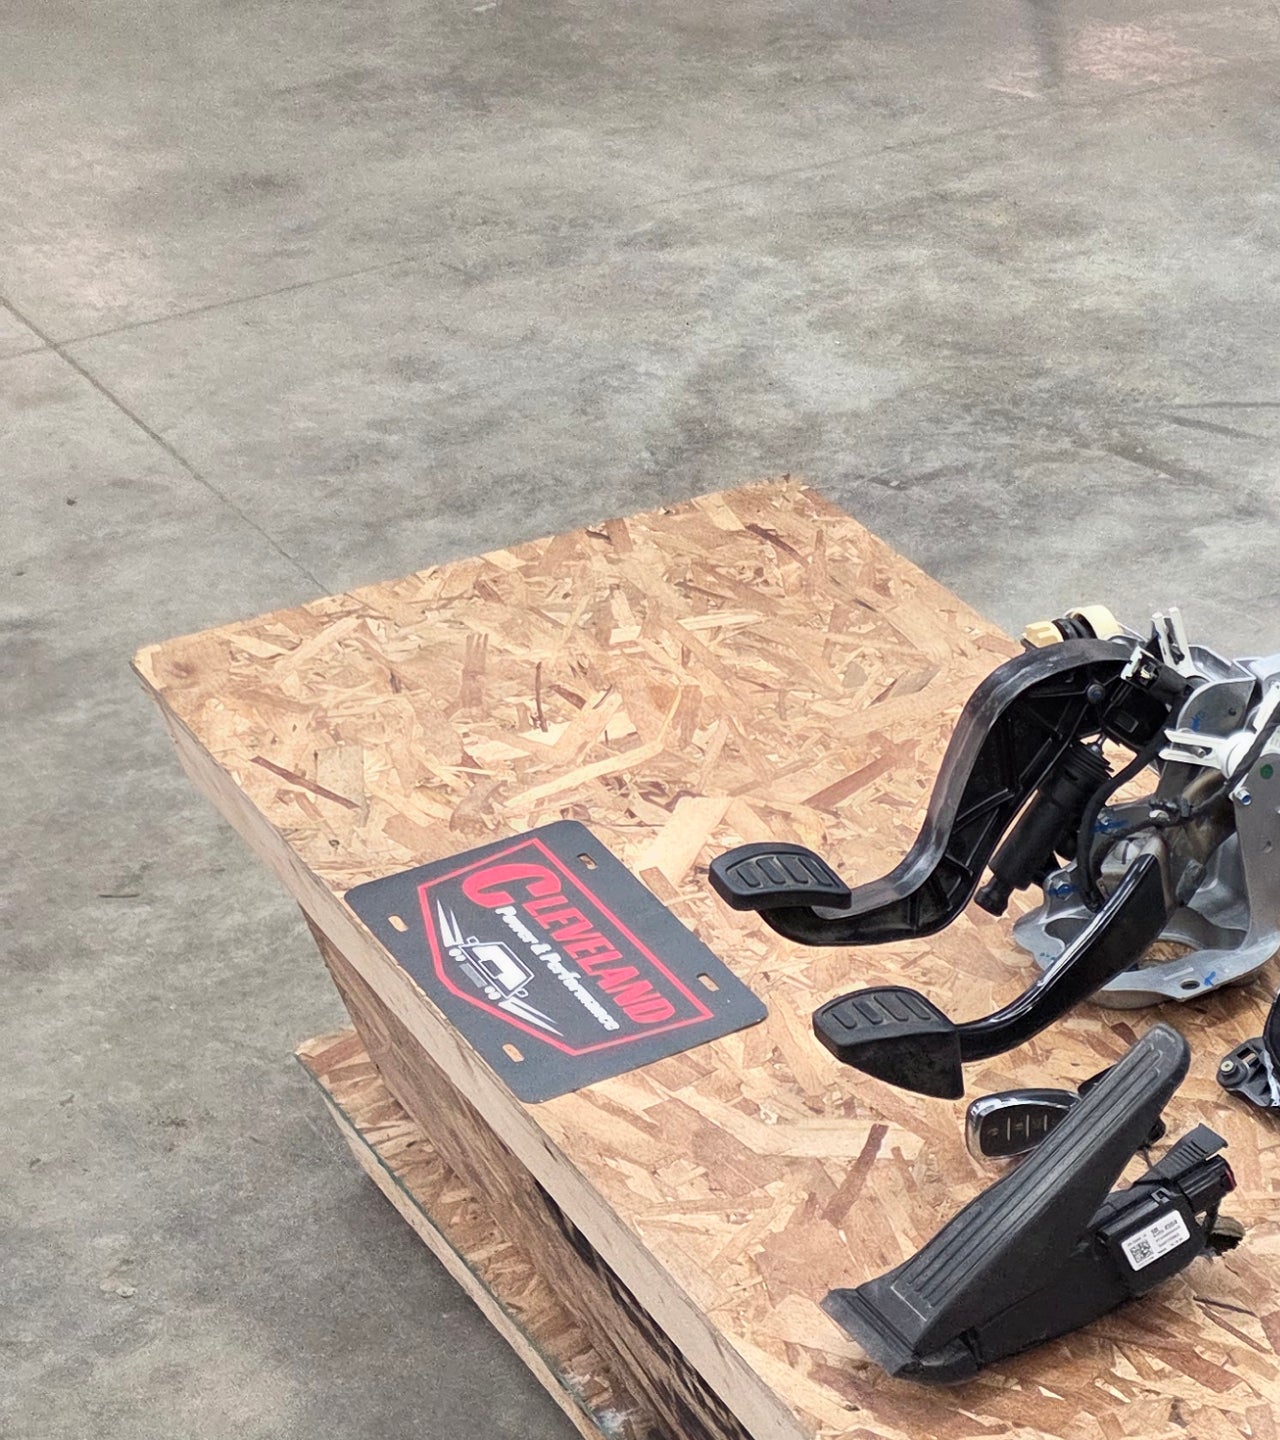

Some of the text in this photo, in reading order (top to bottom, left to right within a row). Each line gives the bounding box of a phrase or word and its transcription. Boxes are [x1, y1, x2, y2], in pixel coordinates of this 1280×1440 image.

[462, 863, 676, 1024] CLEVELAND
[495, 905, 620, 1031] Power & Performance
